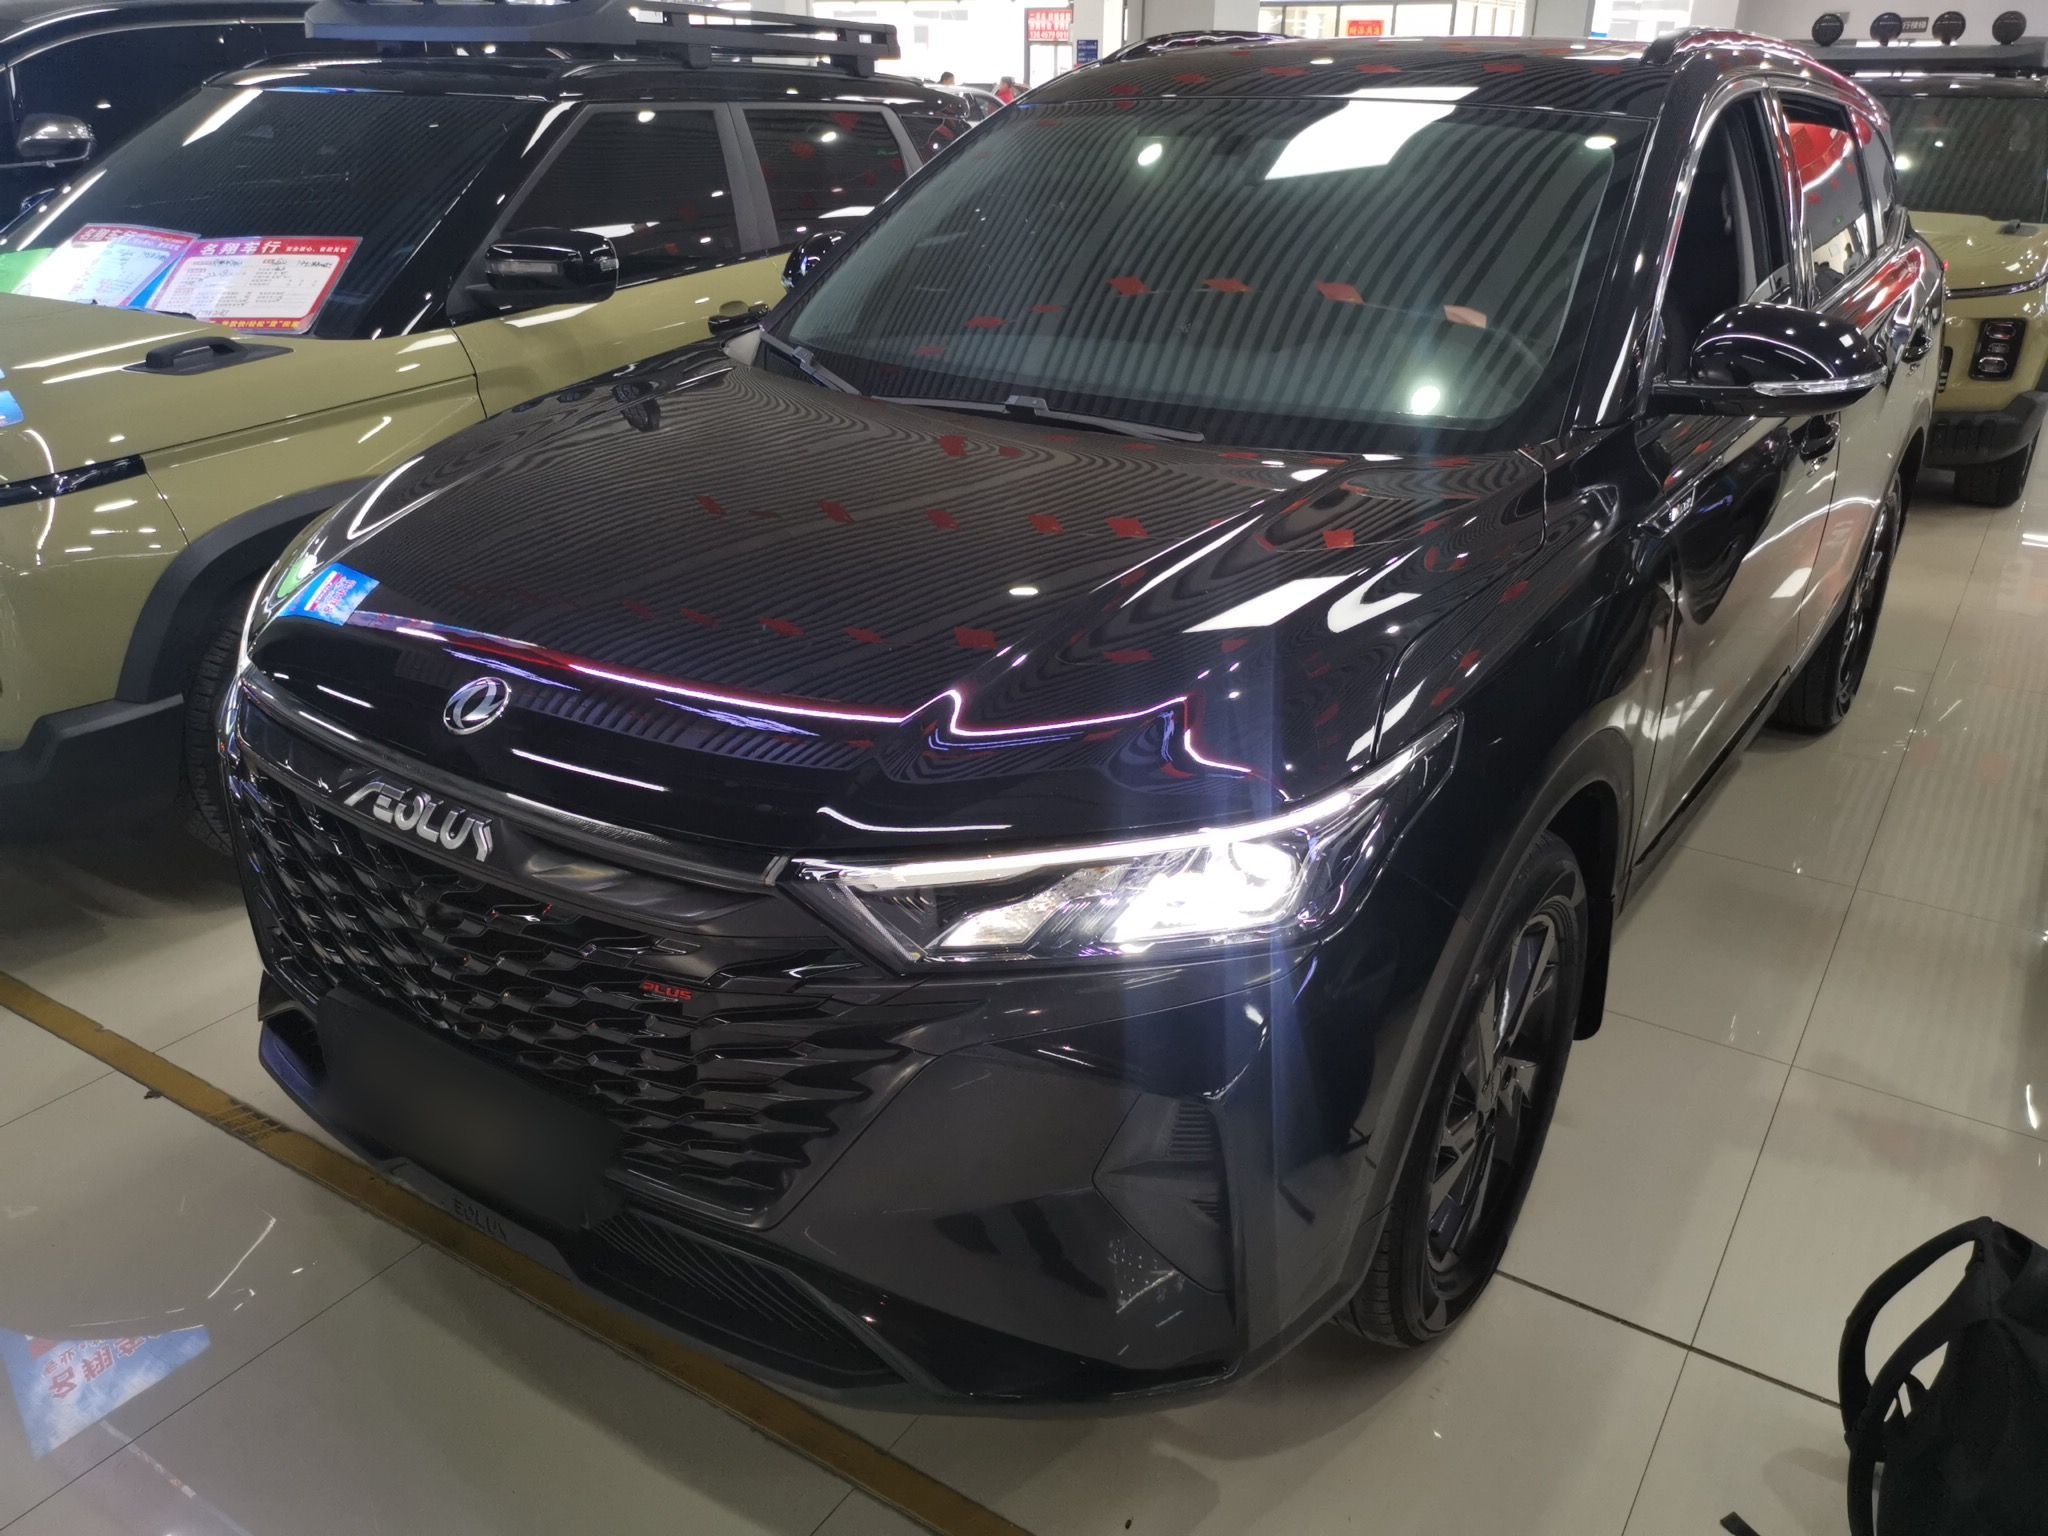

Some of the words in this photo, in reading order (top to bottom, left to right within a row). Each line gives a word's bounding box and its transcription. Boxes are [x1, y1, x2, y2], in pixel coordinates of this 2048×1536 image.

[200, 240, 283, 256] 名翔车行
[642, 980, 694, 1003] PLUS
